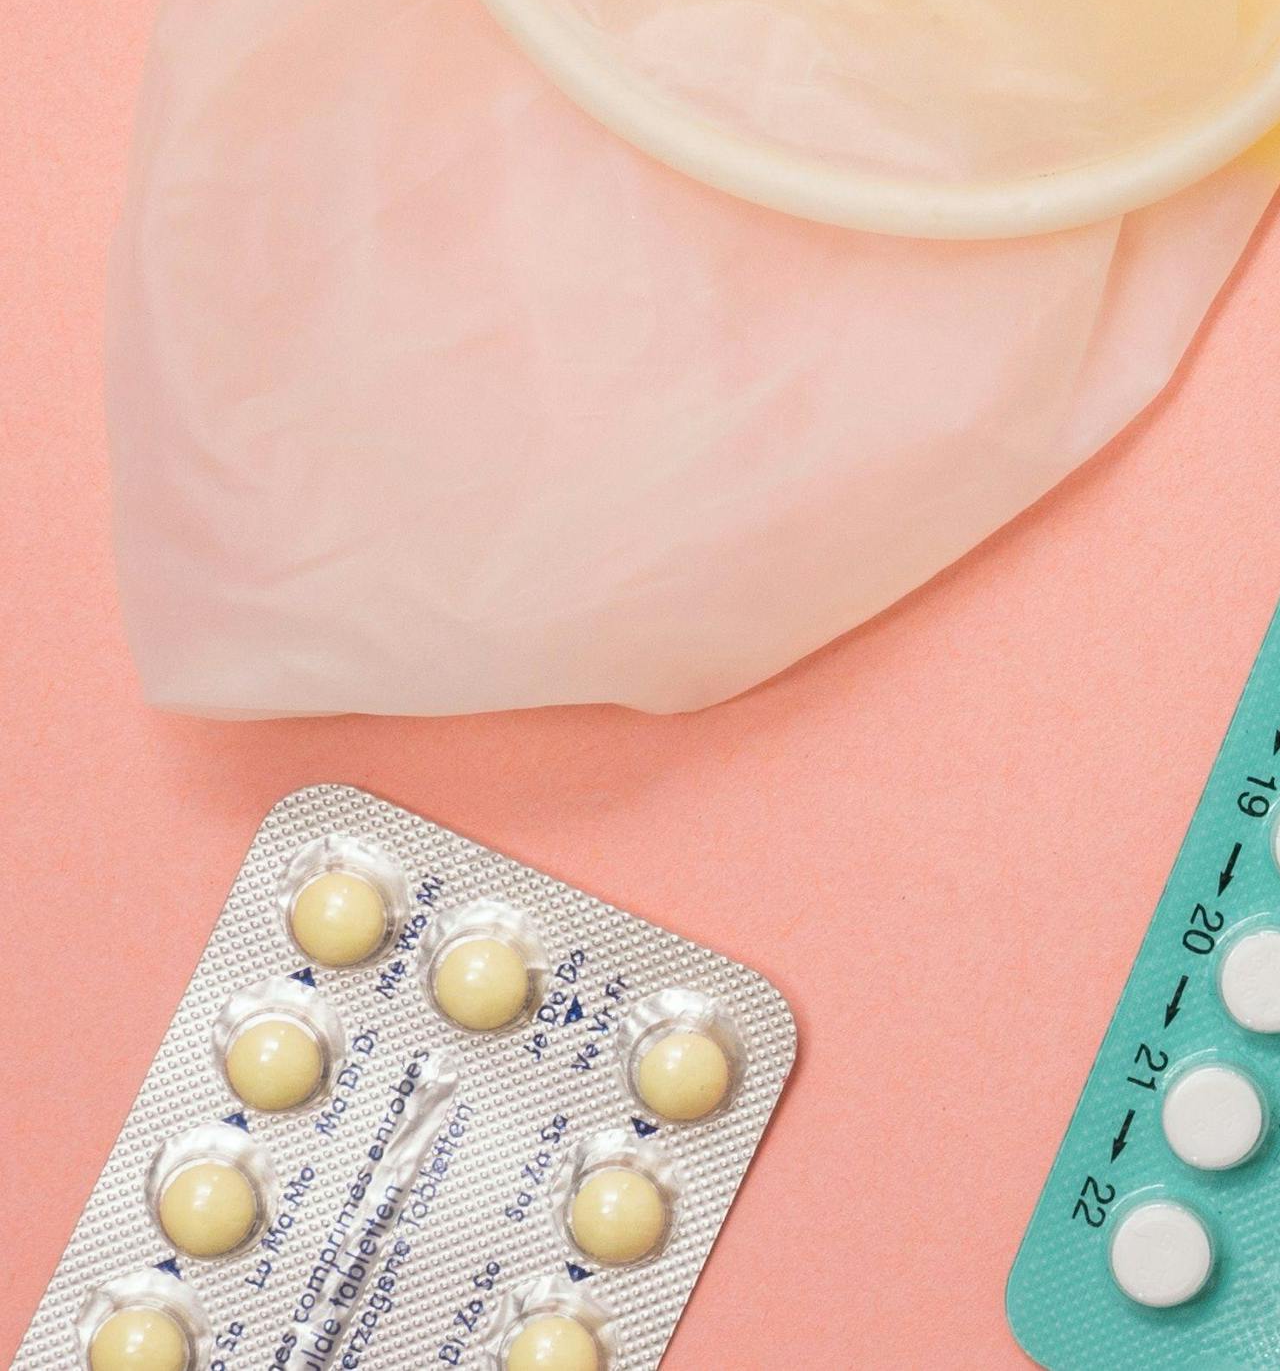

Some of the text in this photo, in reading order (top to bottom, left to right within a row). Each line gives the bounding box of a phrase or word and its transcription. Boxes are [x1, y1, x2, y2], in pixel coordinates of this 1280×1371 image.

[1237, 776, 1278, 818] 19
[376, 873, 445, 1000] Me Wo Mi
[1182, 903, 1225, 956] 20
[523, 949, 586, 1061] Je Do Do
[571, 975, 629, 1071] Ve Vr Fr
[316, 1025, 379, 1138] Ma Di Di
[1127, 1043, 1169, 1091] 21
[294, 1169, 373, 1323] comprimés
[368, 1048, 430, 1162] enrobés
[397, 1102, 473, 1227] Tabletten
[505, 1114, 568, 1222] Sa Za Sa
[1072, 1176, 1117, 1228] 22
[245, 1167, 315, 1289] Lu Ma Mo
[329, 1184, 403, 1308] tabletten
[438, 1261, 500, 1366] Di Zo So
